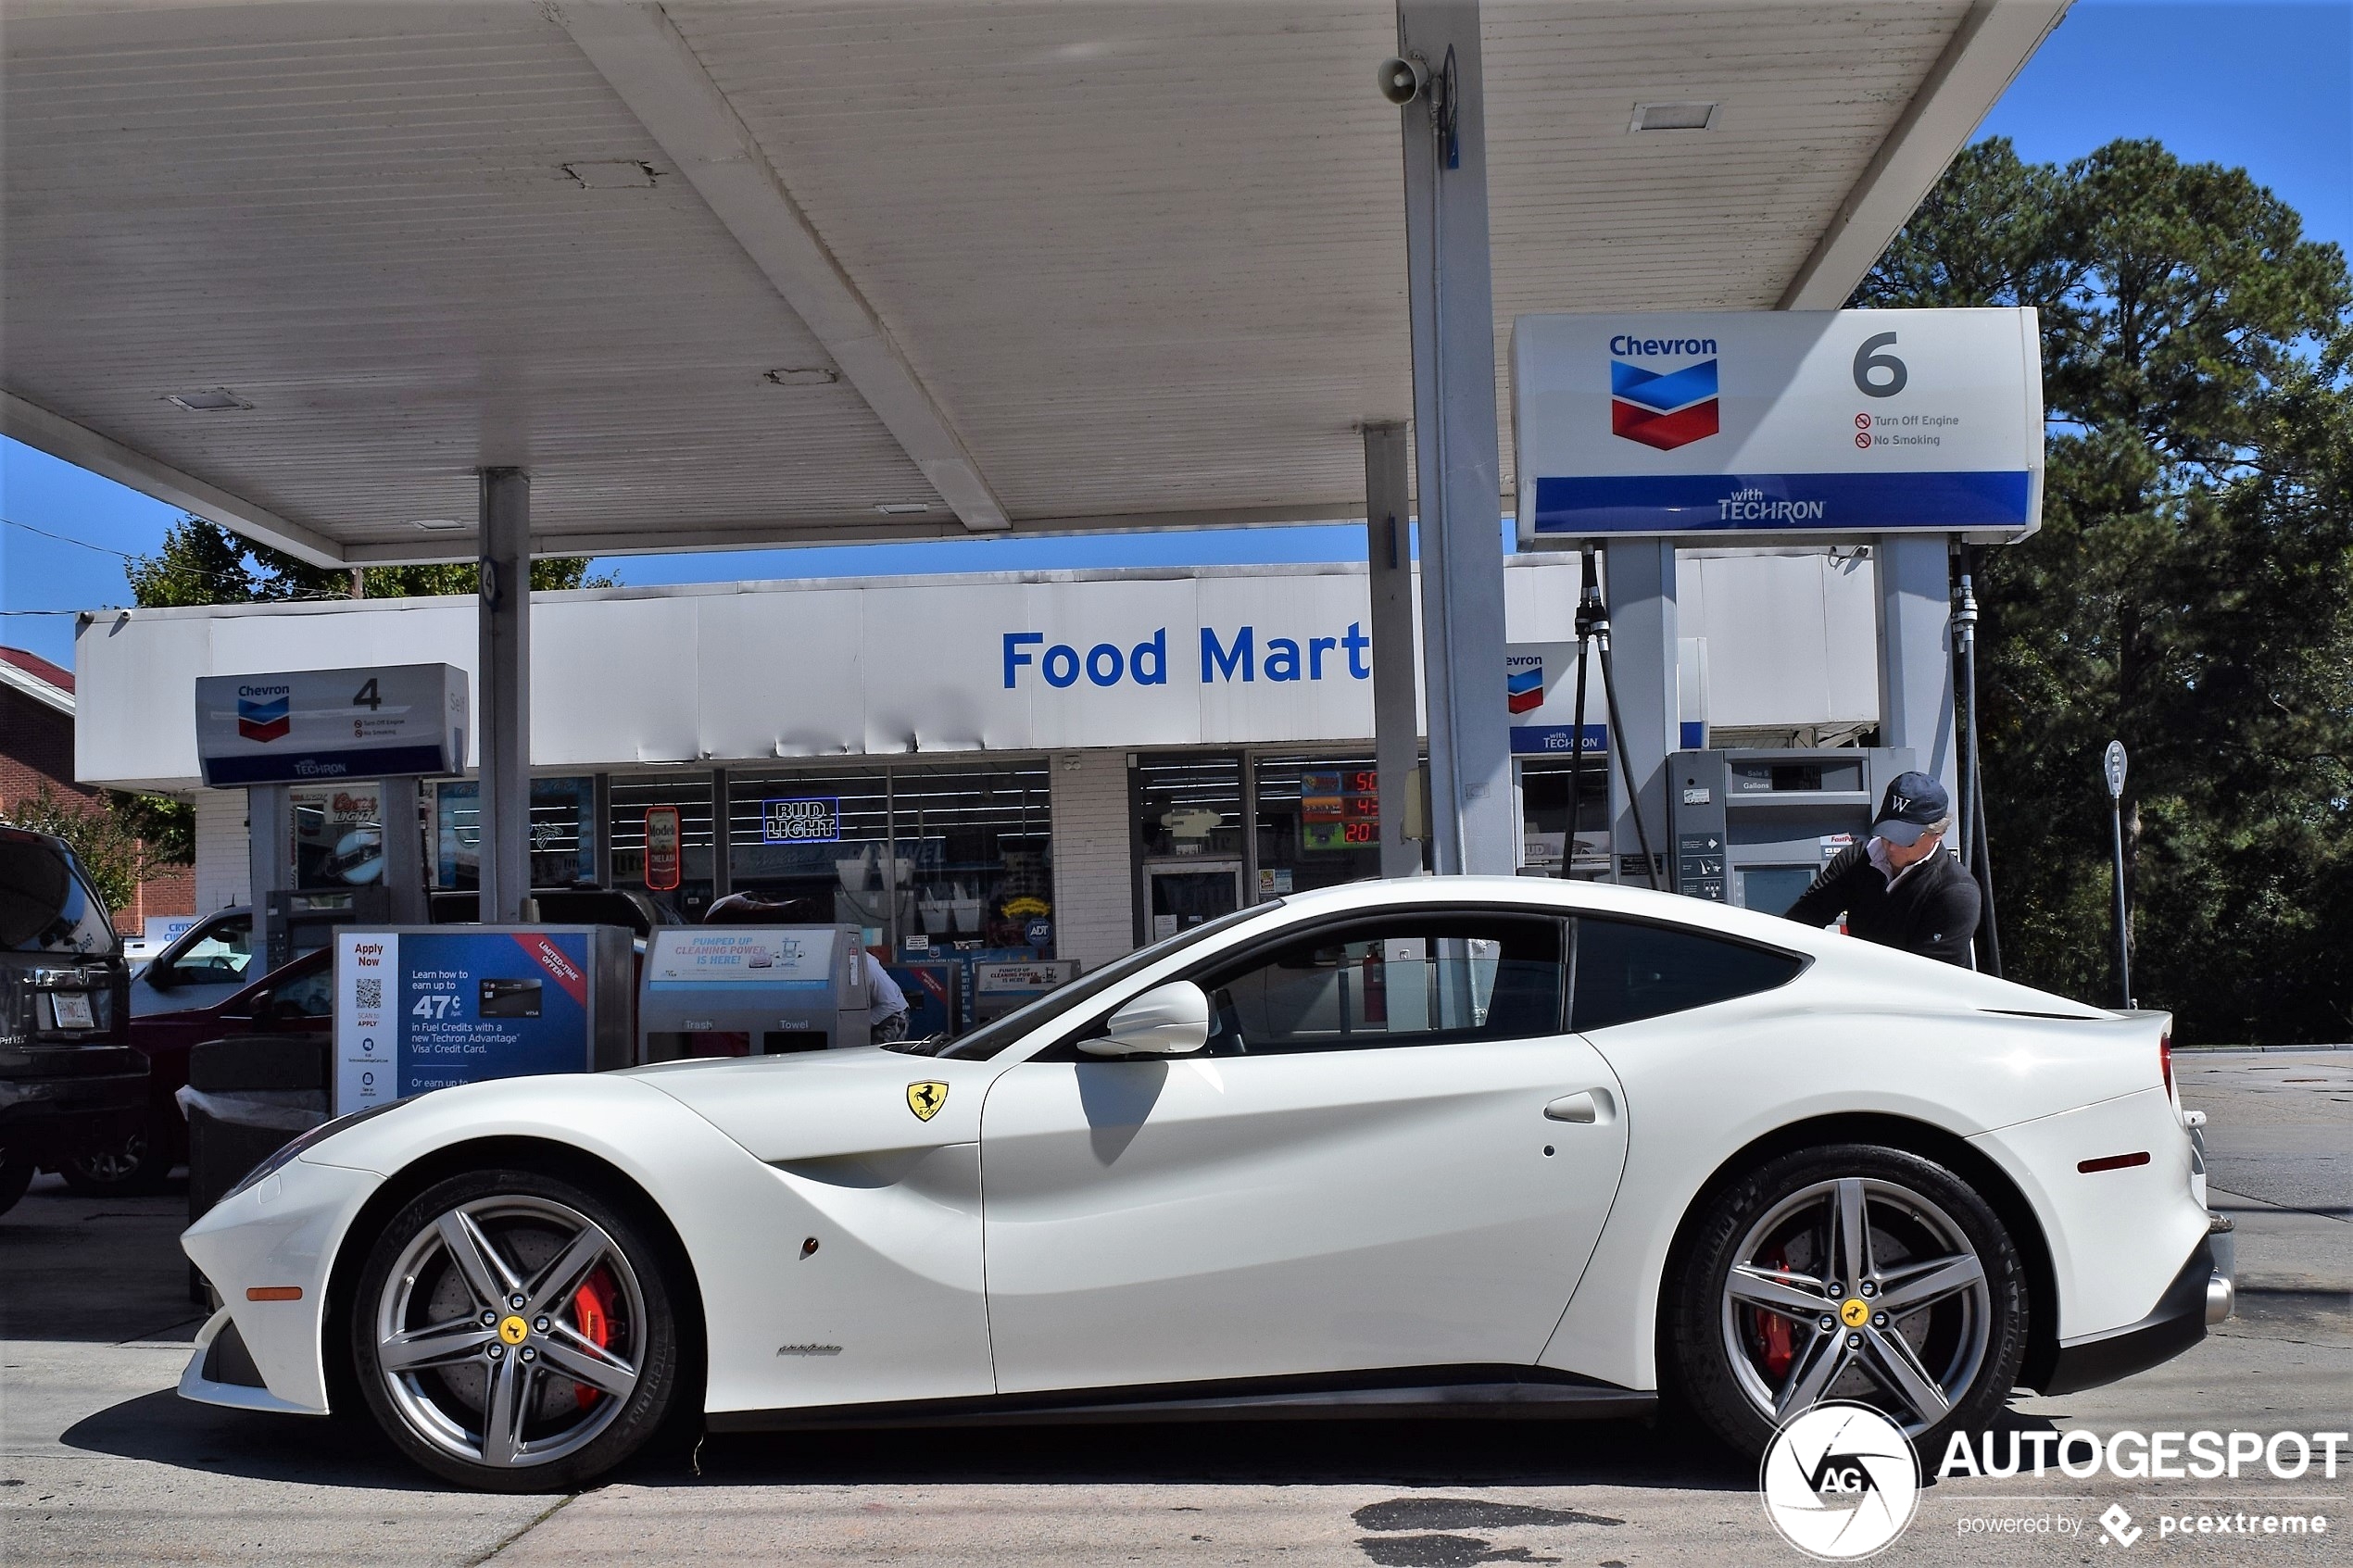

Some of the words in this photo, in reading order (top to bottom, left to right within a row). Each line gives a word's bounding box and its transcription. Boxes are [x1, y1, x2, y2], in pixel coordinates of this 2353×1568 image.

[1609, 334, 1718, 357] Chevron
[1852, 331, 1908, 398] 6
[1874, 415, 1899, 426] Turn
[1902, 414, 1919, 426] Off
[1922, 414, 1959, 428] Engine
[1874, 434, 1890, 445] No
[1893, 434, 1941, 448] Smoking
[1730, 488, 1764, 501] with
[1718, 500, 1824, 523] TECHRON
[1002, 626, 1167, 689] Food
[1200, 621, 1371, 684] Mart
[1506, 655, 1542, 665] evron
[238, 685, 290, 697] Chevron
[353, 678, 382, 711] 4
[1543, 737, 1598, 749] TECHON
[1892, 795, 1911, 813] W
[333, 810, 376, 823] LIGHT
[775, 801, 825, 821] BUD
[766, 819, 836, 839] LIGHT
[1525, 845, 1545, 855] UD
[1029, 925, 1049, 936] ADT
[692, 937, 735, 946] PUMPED
[737, 937, 753, 946] UP
[355, 944, 384, 955] Apply
[675, 947, 727, 955] CLEANING
[730, 946, 766, 955] POWER
[358, 957, 380, 967] Now
[538, 940, 579, 981] LIMITED-TIME
[697, 956, 707, 964] IS
[710, 955, 741, 964] HERE!
[541, 955, 565, 978] OFFER!
[412, 971, 438, 979] Learn
[439, 971, 459, 979] how
[433, 982, 445, 991] up
[446, 981, 456, 989] to
[422, 1022, 439, 1031] Fuel
[441, 1022, 472, 1031] Credits
[475, 1022, 494, 1031] with
[684, 1020, 712, 1029] Trash
[780, 1020, 809, 1029] Towel
[431, 1034, 466, 1042] Techron
[434, 1044, 461, 1053] Credit
[463, 1044, 487, 1053] Card.
[412, 1079, 422, 1087] Or
